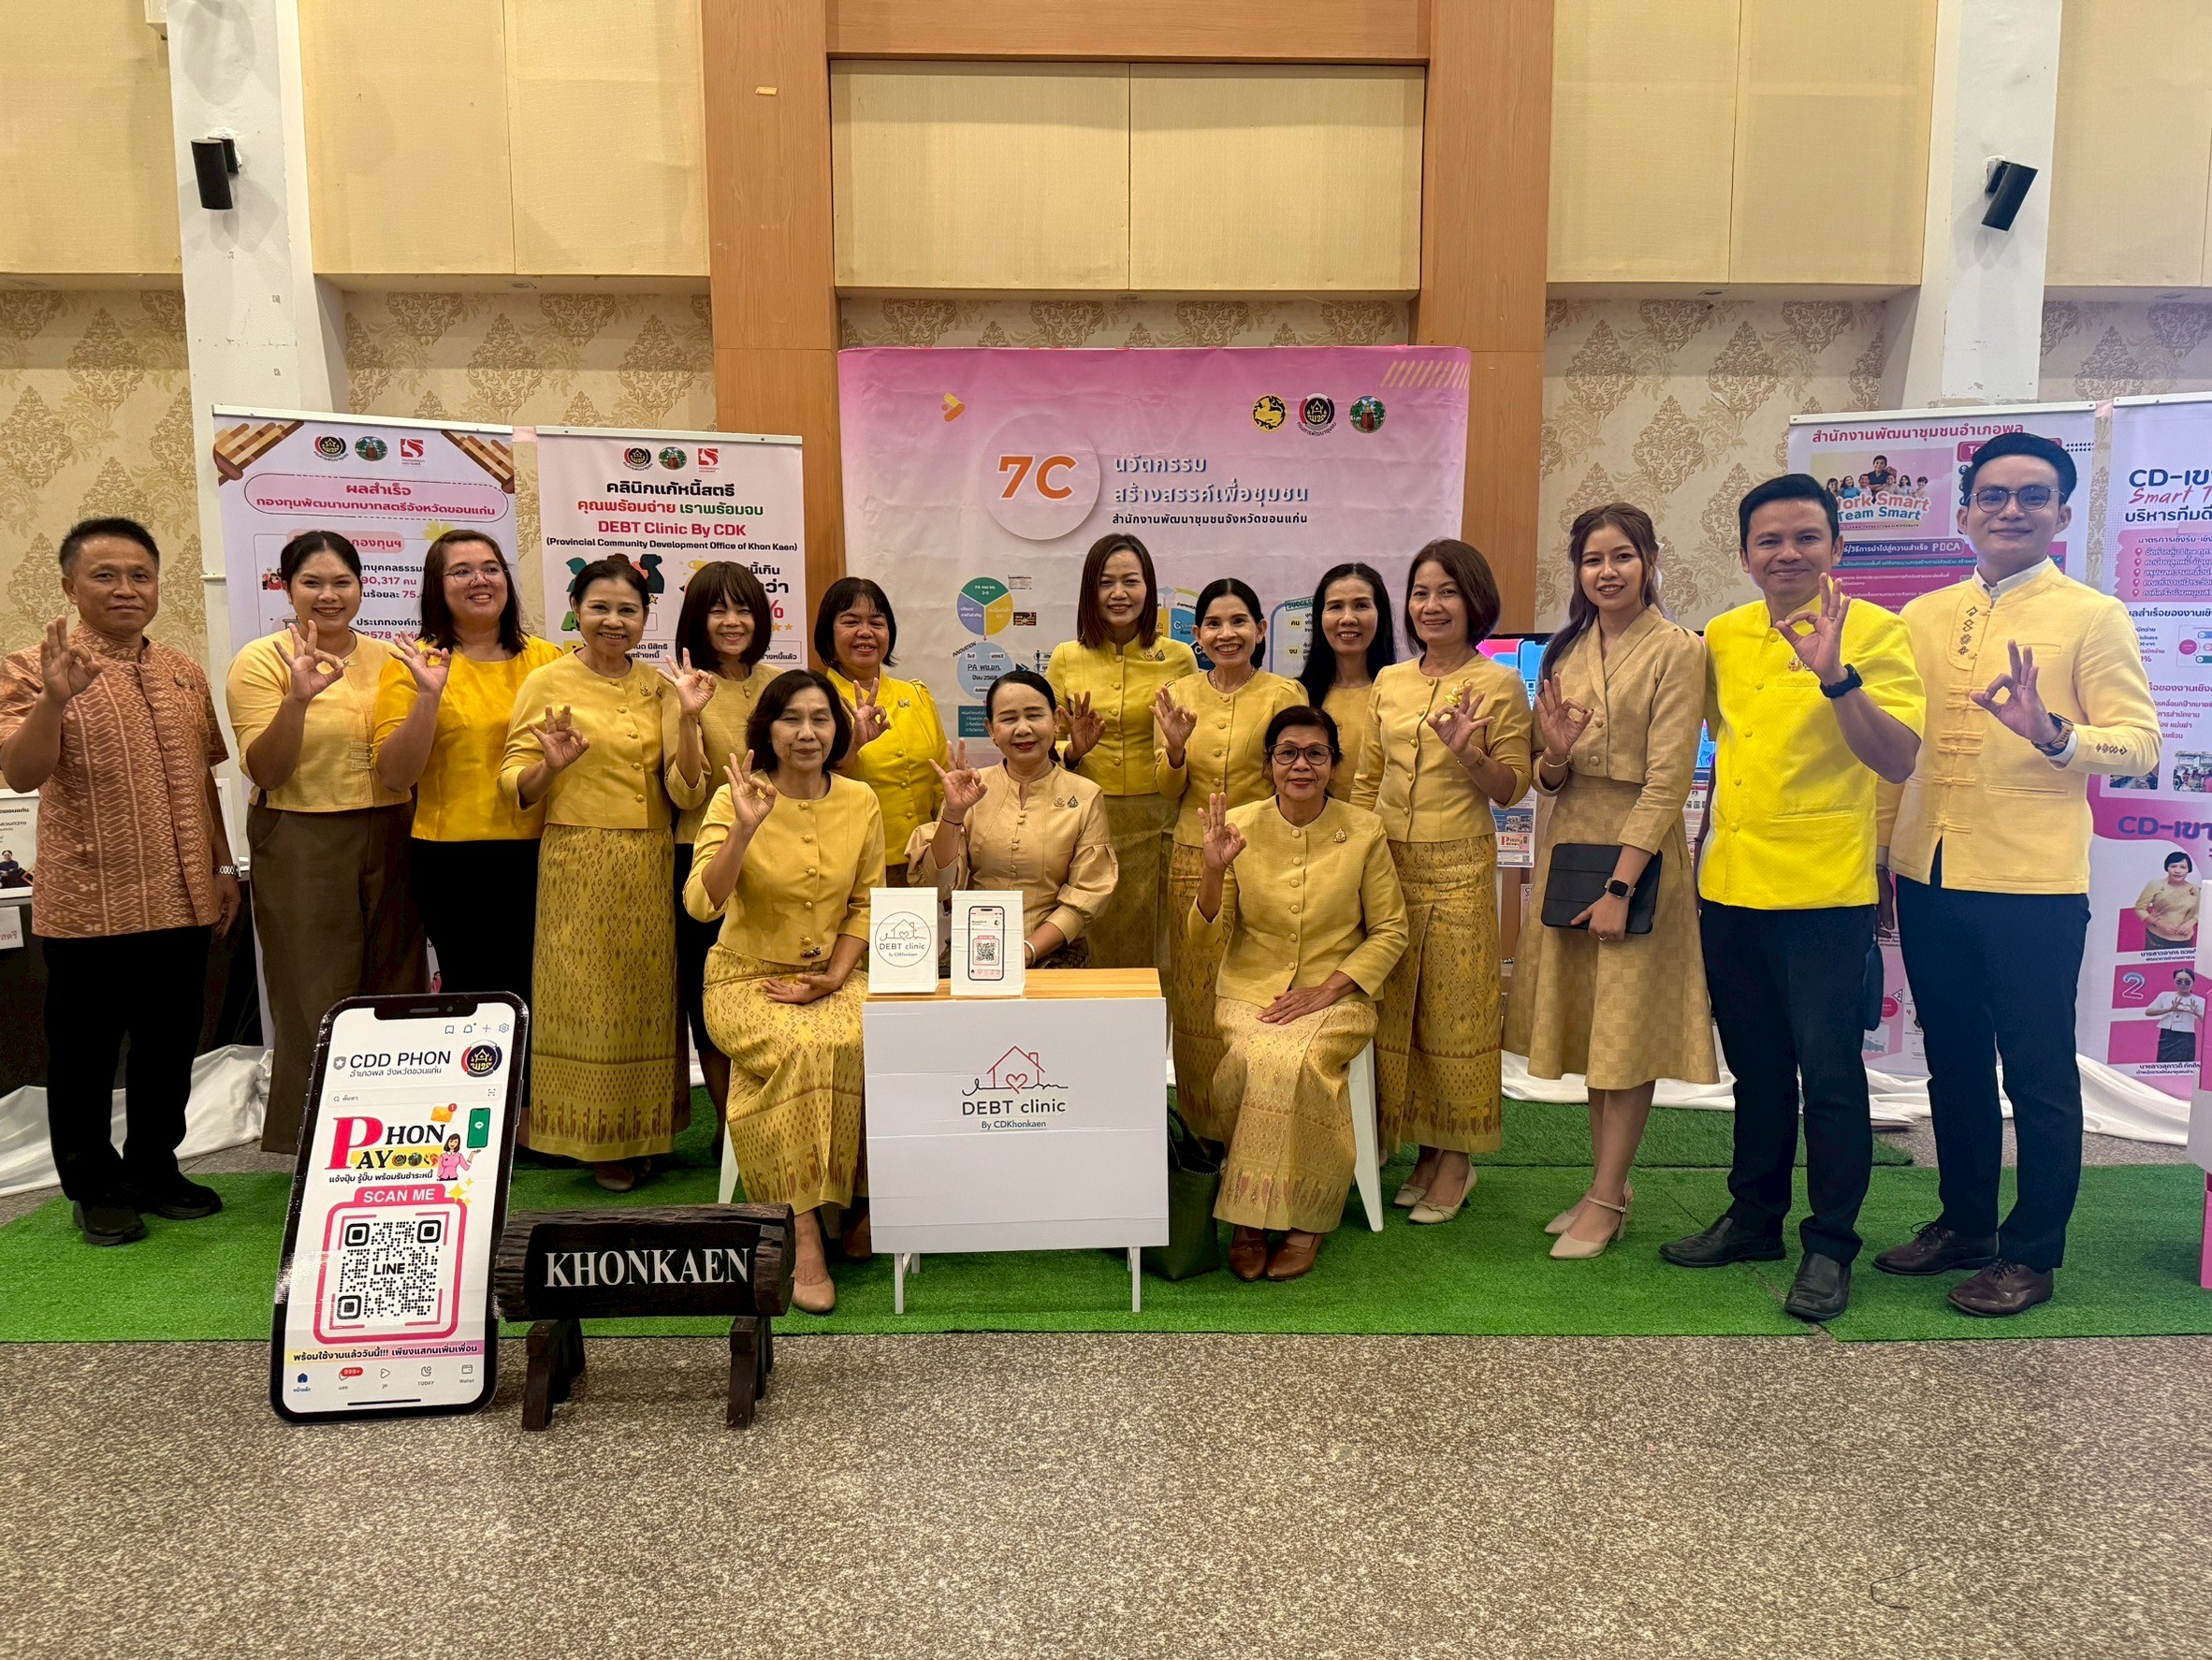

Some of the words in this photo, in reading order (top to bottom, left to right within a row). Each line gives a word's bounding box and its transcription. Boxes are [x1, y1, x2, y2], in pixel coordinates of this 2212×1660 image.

[1812, 423, 2024, 443] สำนักงานพัฒนาชุมชนอำเภอพล
[1113, 455, 1207, 473] นวัตกรรม
[997, 454, 1078, 500] 7C
[2129, 469, 2212, 488] CD-เข
[346, 483, 412, 496] ผลสำเร็จ
[606, 478, 735, 497] คลินิกแก้หนี้สตรี
[1113, 478, 1309, 507] สร้างสรรค์เพื่อชุมชน
[2129, 485, 2194, 504] Smart
[256, 497, 495, 516] กองทุนพัฒนาบทบาทสตรีจังหวัดขอนแก่น
[577, 499, 676, 516] คุณพร้อมจ่าย
[680, 502, 764, 516] เราพร้อมจบ
[1838, 493, 1872, 510] ork
[1876, 492, 1929, 511] Smart
[1112, 513, 1308, 527] สำนักงานพัฒนาชุมชนจังหวัดขอนแก่น
[1838, 509, 1873, 522] Team
[1878, 506, 1921, 520] Smart
[598, 520, 641, 533] DEBT
[644, 522, 688, 535] Clinic
[691, 523, 711, 538] By
[713, 523, 747, 536] CDK
[546, 537, 596, 546] (Provincial
[597, 538, 648, 549] Community
[649, 540, 708, 551] Development
[709, 541, 735, 550] Office
[737, 542, 747, 550] of
[748, 542, 770, 550] Khon
[772, 543, 797, 552] Kaen)
[360, 564, 425, 574] ทบุคคลธรรม
[749, 561, 780, 575] นี้เกิน
[764, 578, 789, 593] ว่า
[362, 590, 400, 599] นร้อยละ
[402, 590, 421, 599] 75.
[2129, 607, 2212, 617] ลสำเร็จของงานเชิ
[762, 652, 797, 661] างหนี้แล้ว
[879, 942, 902, 951] DEBT
[2121, 972, 2146, 1000] 2
[350, 1053, 391, 1069] CDD
[398, 1050, 451, 1066] PHON
[349, 1067, 385, 1078] อำเภอพล
[386, 1065, 442, 1076] จังหวัดขอนแก่น
[962, 1100, 1013, 1115] DEBT
[1020, 1099, 1066, 1114] clinic
[982, 1121, 992, 1130] By
[993, 1119, 1046, 1129] CDKhonkaen
[363, 1189, 408, 1202] SCAN
[413, 1188, 435, 1201] ME
[373, 1263, 405, 1275] LINE
[544, 1248, 750, 1288] KHONKAEN
[391, 1344, 478, 1357] เพียงแสกนเพิ่มเพื่อน
